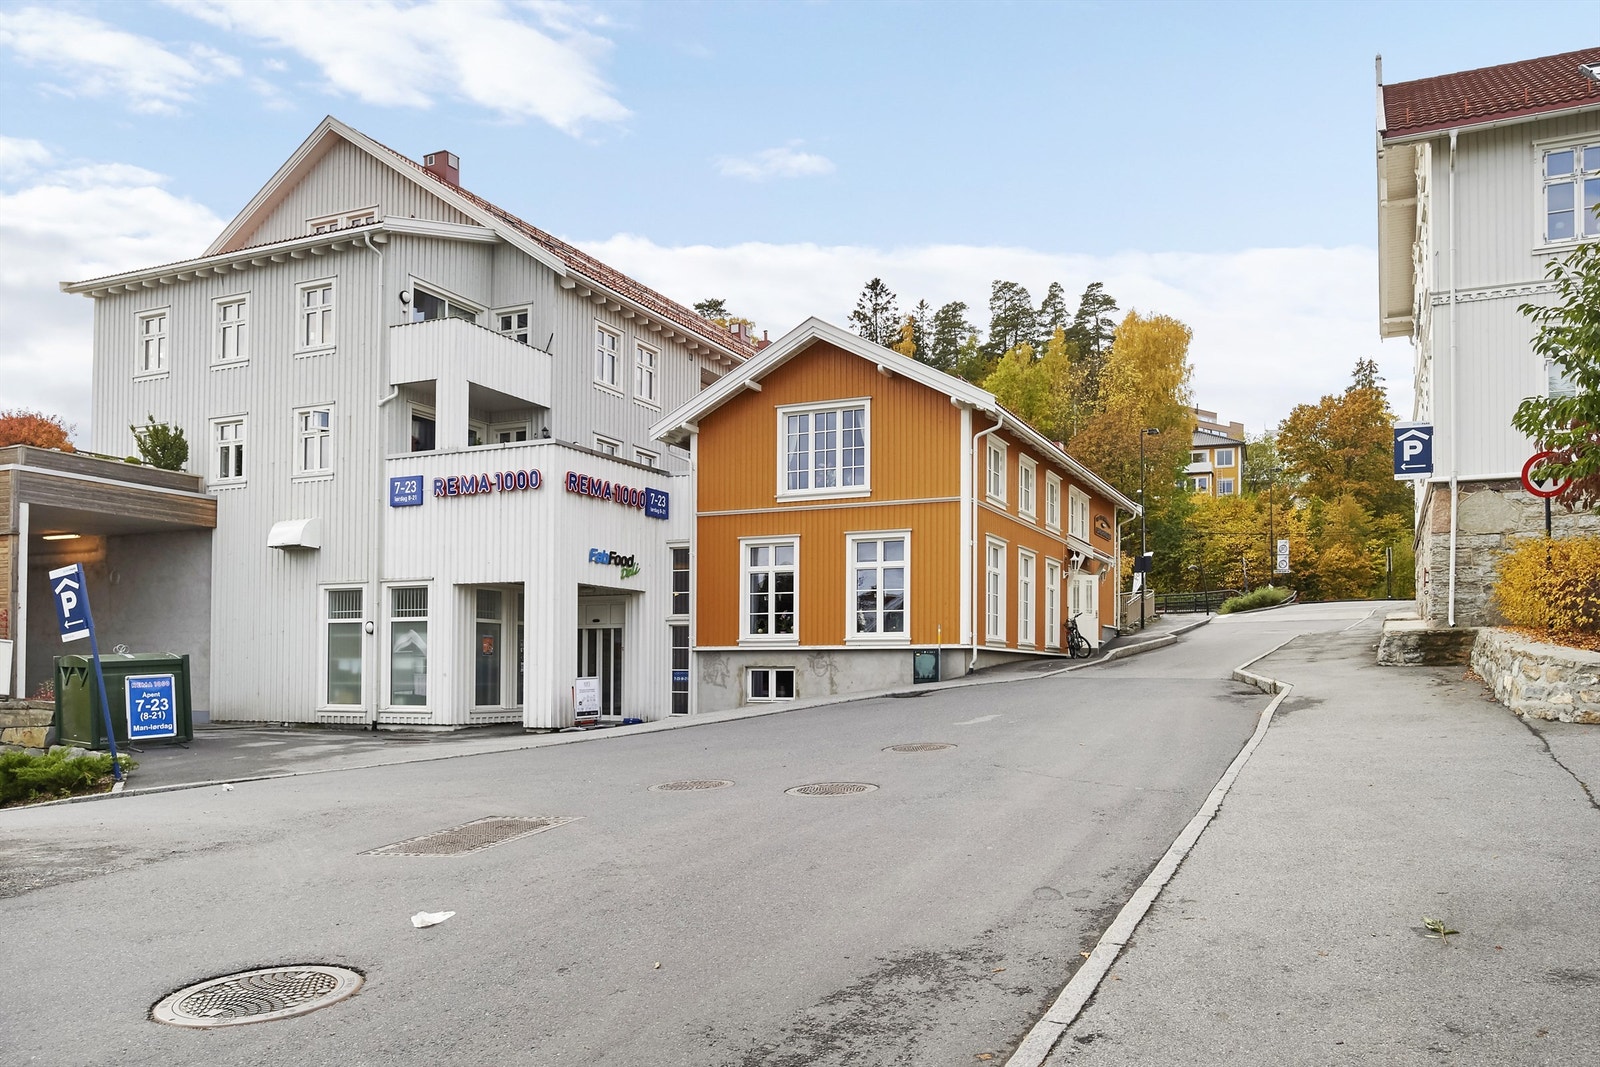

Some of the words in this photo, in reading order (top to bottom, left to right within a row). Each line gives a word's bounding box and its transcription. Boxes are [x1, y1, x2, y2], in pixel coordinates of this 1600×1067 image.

[1403, 440, 1423, 461] P
[394, 480, 417, 494] 7-23
[433, 473, 491, 498] REMA
[494, 468, 542, 492] 1000
[566, 471, 612, 502] REMA
[614, 483, 646, 509] 1000
[650, 492, 666, 507] 7-23
[60, 590, 78, 618] P
[153, 680, 171, 688] 1000
[135, 698, 169, 712] 7-23
[140, 711, 166, 721] (8-21)
[133, 723, 173, 732] Man-lørdag
